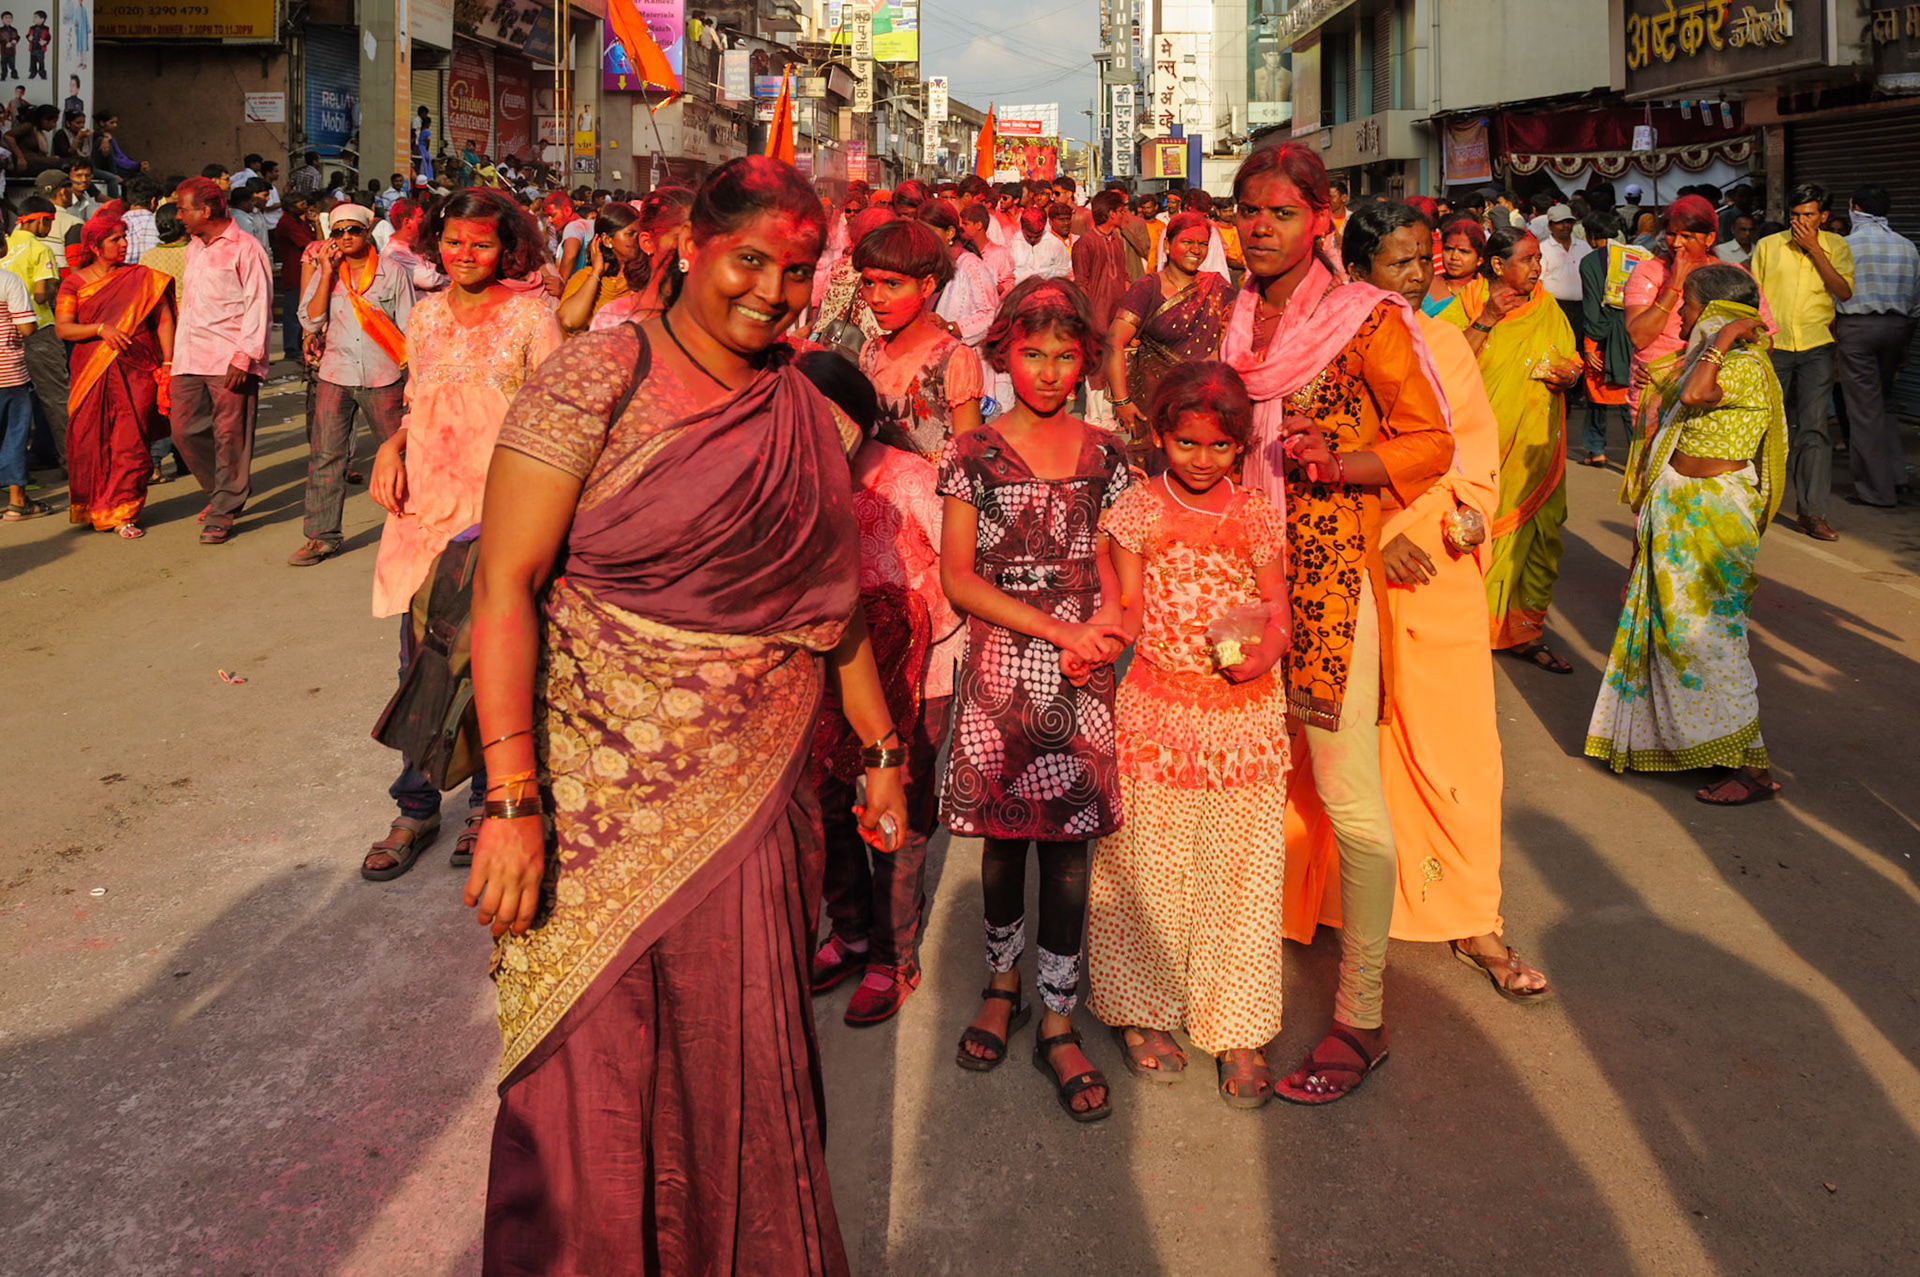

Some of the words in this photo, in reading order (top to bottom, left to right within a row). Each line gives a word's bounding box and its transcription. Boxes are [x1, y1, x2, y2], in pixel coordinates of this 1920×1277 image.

[149, 6, 177, 17] 3290
[180, 6, 209, 16] 4793
[640, 11, 674, 19] Materials
[214, 25, 224, 35] TO
[1627, 0, 1729, 70] अष्टेकर
[449, 80, 490, 115] Sindoor
